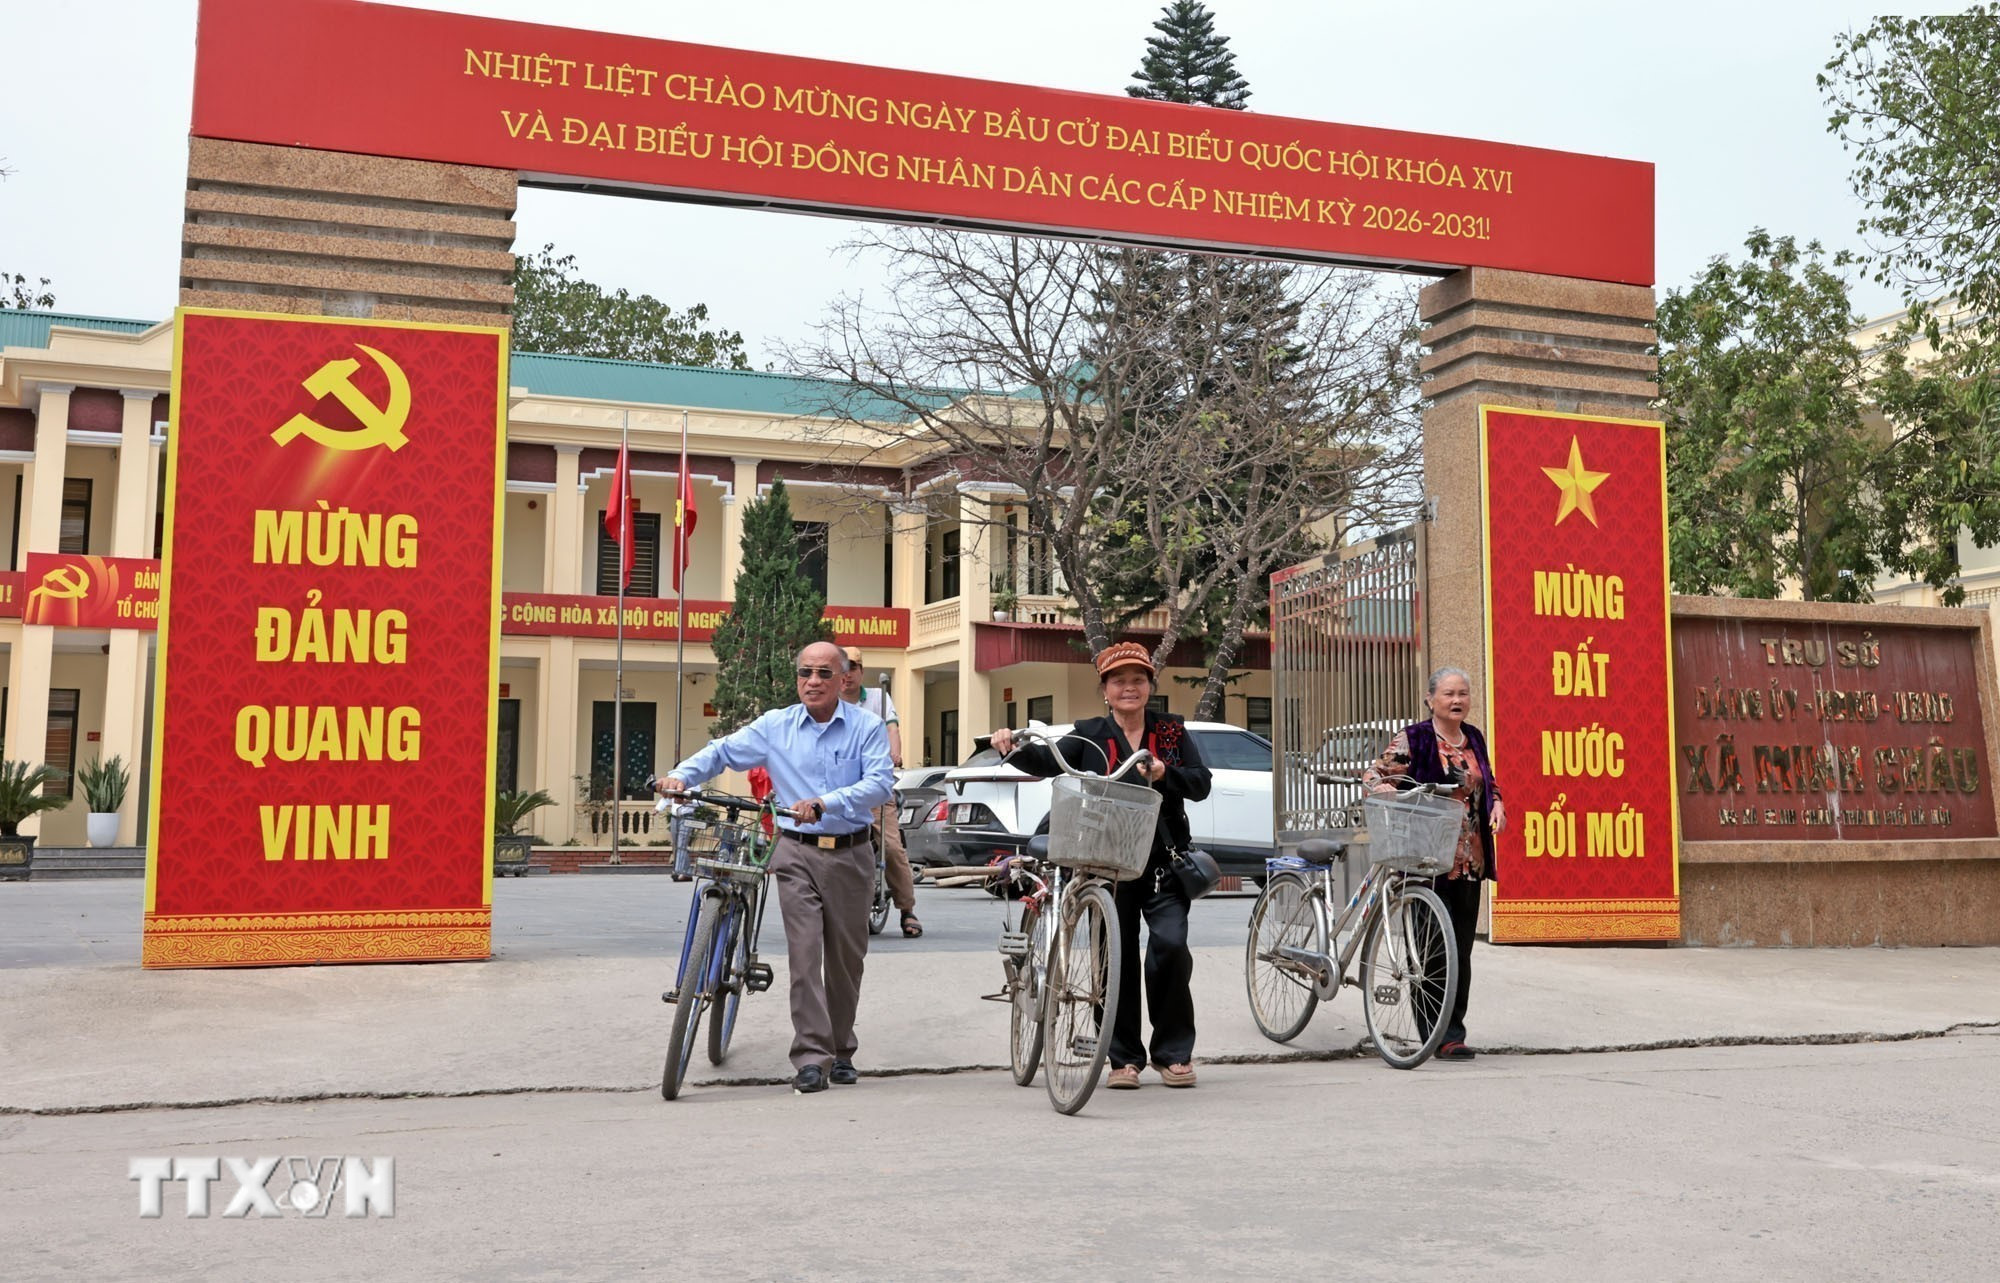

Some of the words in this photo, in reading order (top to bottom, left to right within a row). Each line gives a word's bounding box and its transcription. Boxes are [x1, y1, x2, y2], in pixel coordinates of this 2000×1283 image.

[464, 48, 577, 87] NHIỆT
[584, 63, 658, 97] LIỆT
[665, 73, 766, 109] CHÀO
[773, 86, 878, 123] MỪNG
[885, 100, 976, 133] NGÀY
[983, 107, 1050, 142] BẦU
[1057, 116, 1100, 147] CỬ
[1106, 124, 1160, 156] ĐẠI
[1167, 129, 1233, 163] BIỂU
[1239, 139, 1322, 173] QUỐC
[1328, 149, 1378, 180] HỘI
[1386, 156, 1467, 188] KHÓA
[1472, 167, 1513, 194] XVI
[501, 109, 553, 142] VÀ
[562, 117, 626, 151] ĐẠI
[634, 121, 712, 158] BIỂU
[721, 134, 783, 169] HỘI
[791, 140, 889, 178] ĐỒNG
[897, 155, 994, 189] NHÂN
[1003, 164, 1072, 197] DÂN
[1079, 176, 1141, 205] CÁC
[1147, 180, 1207, 210] CẤP
[1213, 190, 1311, 223] NHIỆM
[1317, 200, 1357, 226] KỲ
[1363, 204, 1490, 240] 2026-2031!
[253, 500, 418, 568] MỪNG
[116, 593, 133, 618] TỔ
[134, 597, 160, 619] CHỨ
[134, 565, 160, 590] ĐẢN
[1533, 563, 1625, 620] MỪNG
[254, 588, 408, 665] ĐẢNG
[512, 602, 557, 626] CỘNG
[560, 603, 593, 625] HÒA
[596, 605, 618, 626] XÃ
[622, 606, 649, 630] HỘI
[859, 616, 898, 636] NĂM!
[1552, 636, 1610, 698] ĐẤT
[1760, 637, 1826, 674] TRỤ
[1837, 630, 1881, 668] SỞ
[234, 703, 422, 769] QUANG
[1541, 722, 1625, 778] NƯỚC
[1683, 733, 1745, 792] XÃ
[1874, 735, 1979, 794] CHÂU
[259, 804, 391, 862] VINH
[1524, 792, 1577, 858] ĐỔI
[1586, 802, 1645, 858] MỚI
